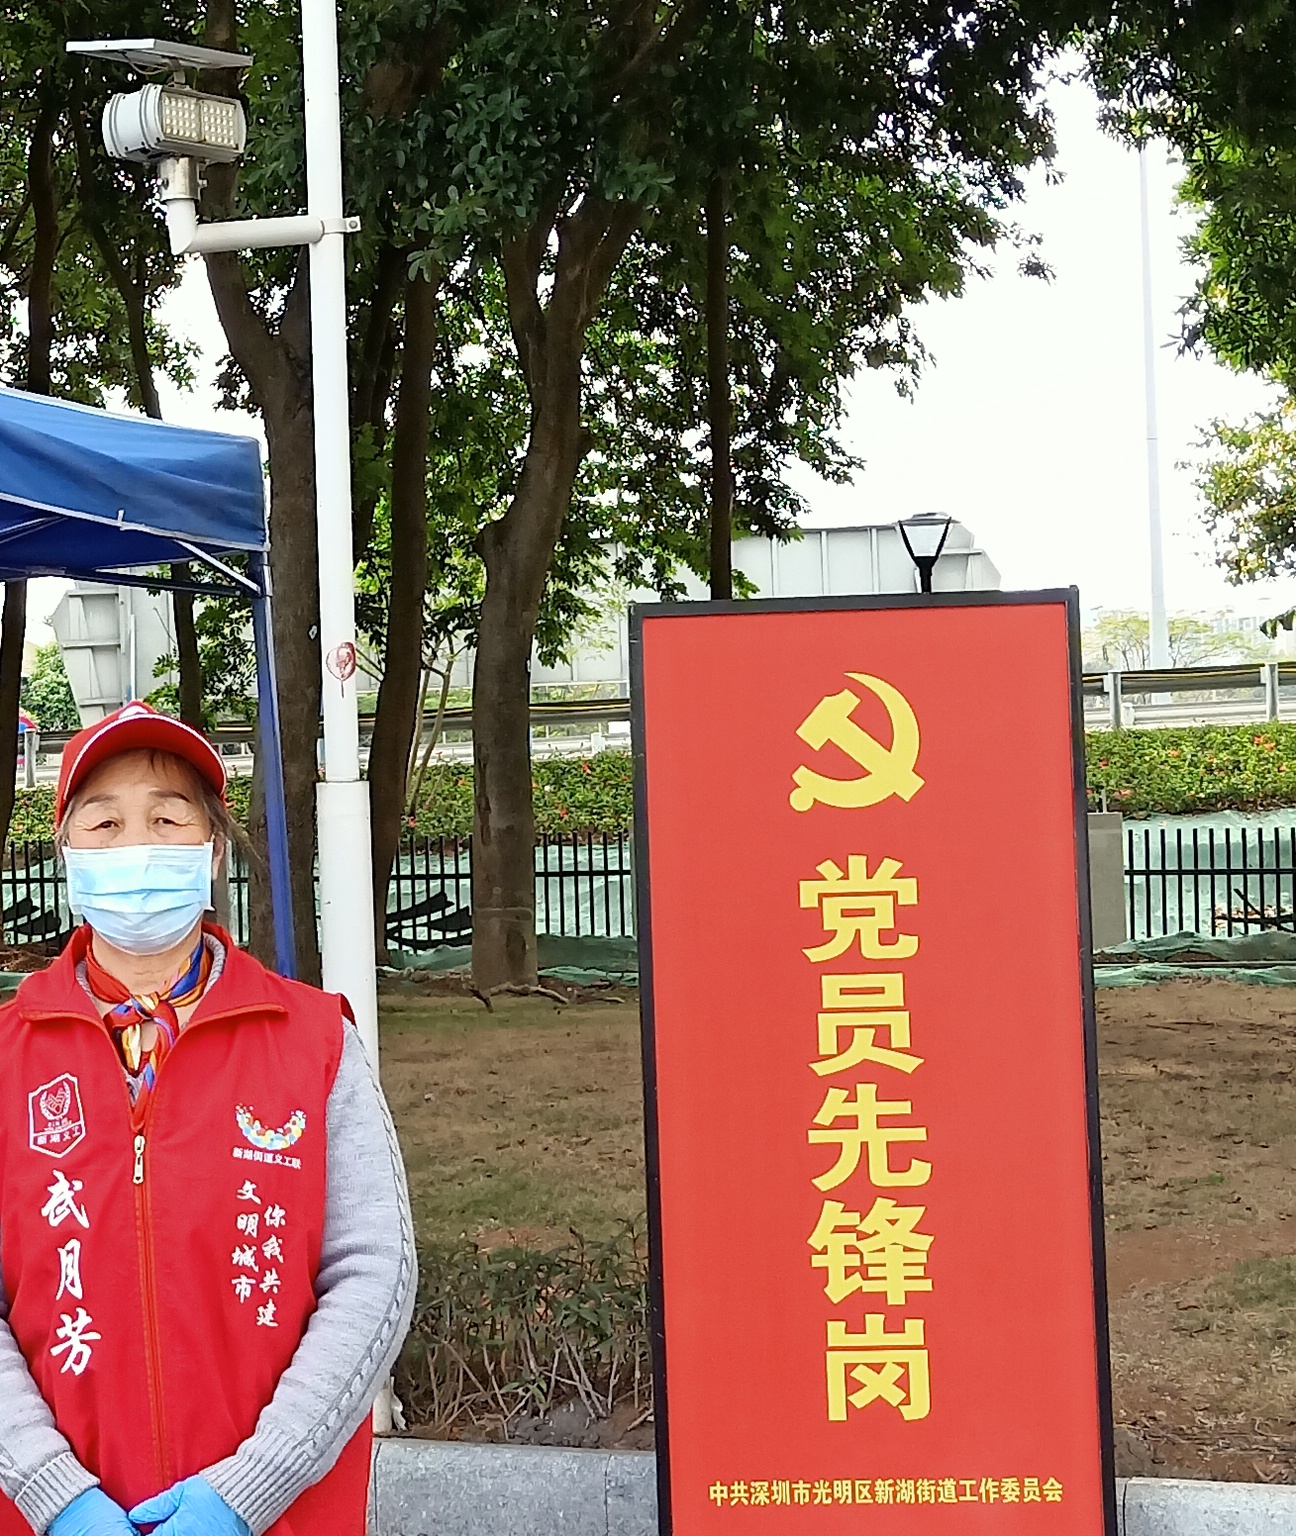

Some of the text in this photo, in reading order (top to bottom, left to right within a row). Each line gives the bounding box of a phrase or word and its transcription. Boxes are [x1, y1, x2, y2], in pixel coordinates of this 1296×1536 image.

[799, 854, 934, 1421] 党员先锋岗
[41, 1169, 102, 1376] 武月芳
[231, 1180, 261, 1304] 文明城市
[257, 1203, 286, 1327] 你我共建
[709, 1476, 1063, 1507] 中共深圳市光明区新湖街道工作委员会
